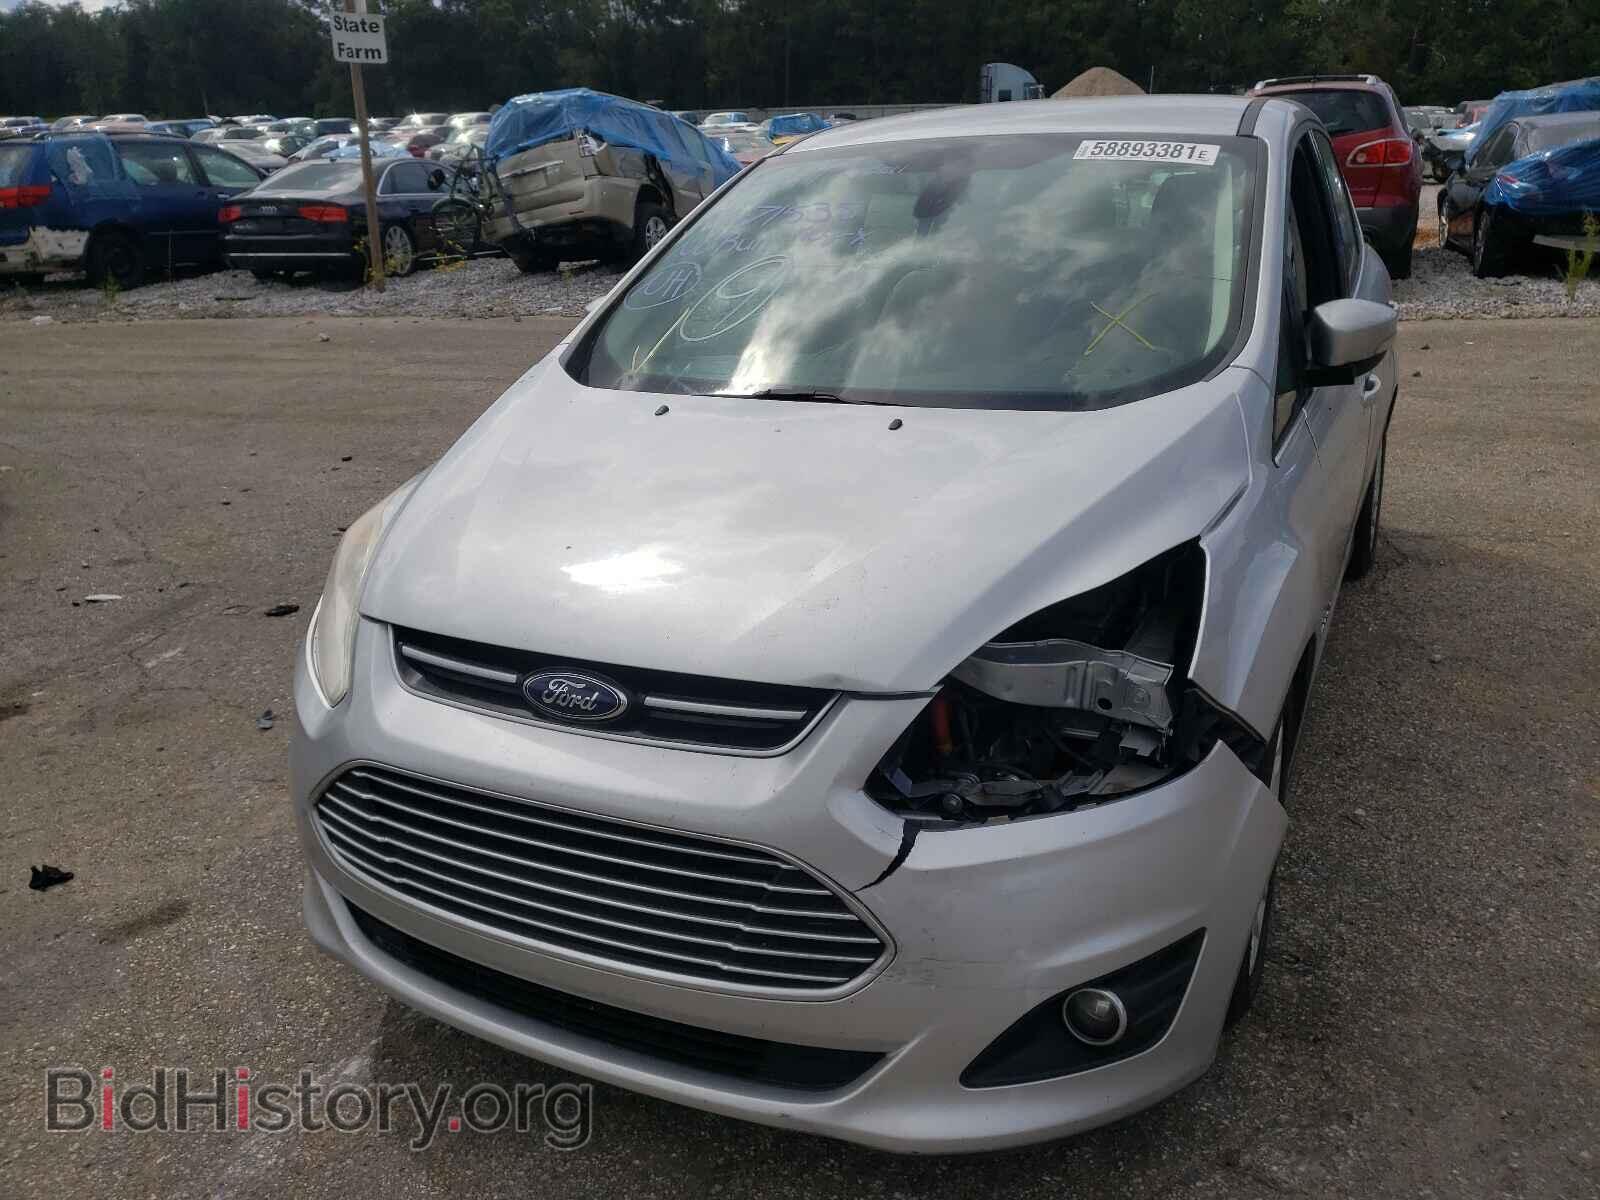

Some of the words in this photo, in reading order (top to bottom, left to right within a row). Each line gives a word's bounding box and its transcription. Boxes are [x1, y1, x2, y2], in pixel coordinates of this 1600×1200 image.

[333, 15, 380, 33] State
[337, 42, 382, 59] Farm
[542, 679, 600, 711] Ford
